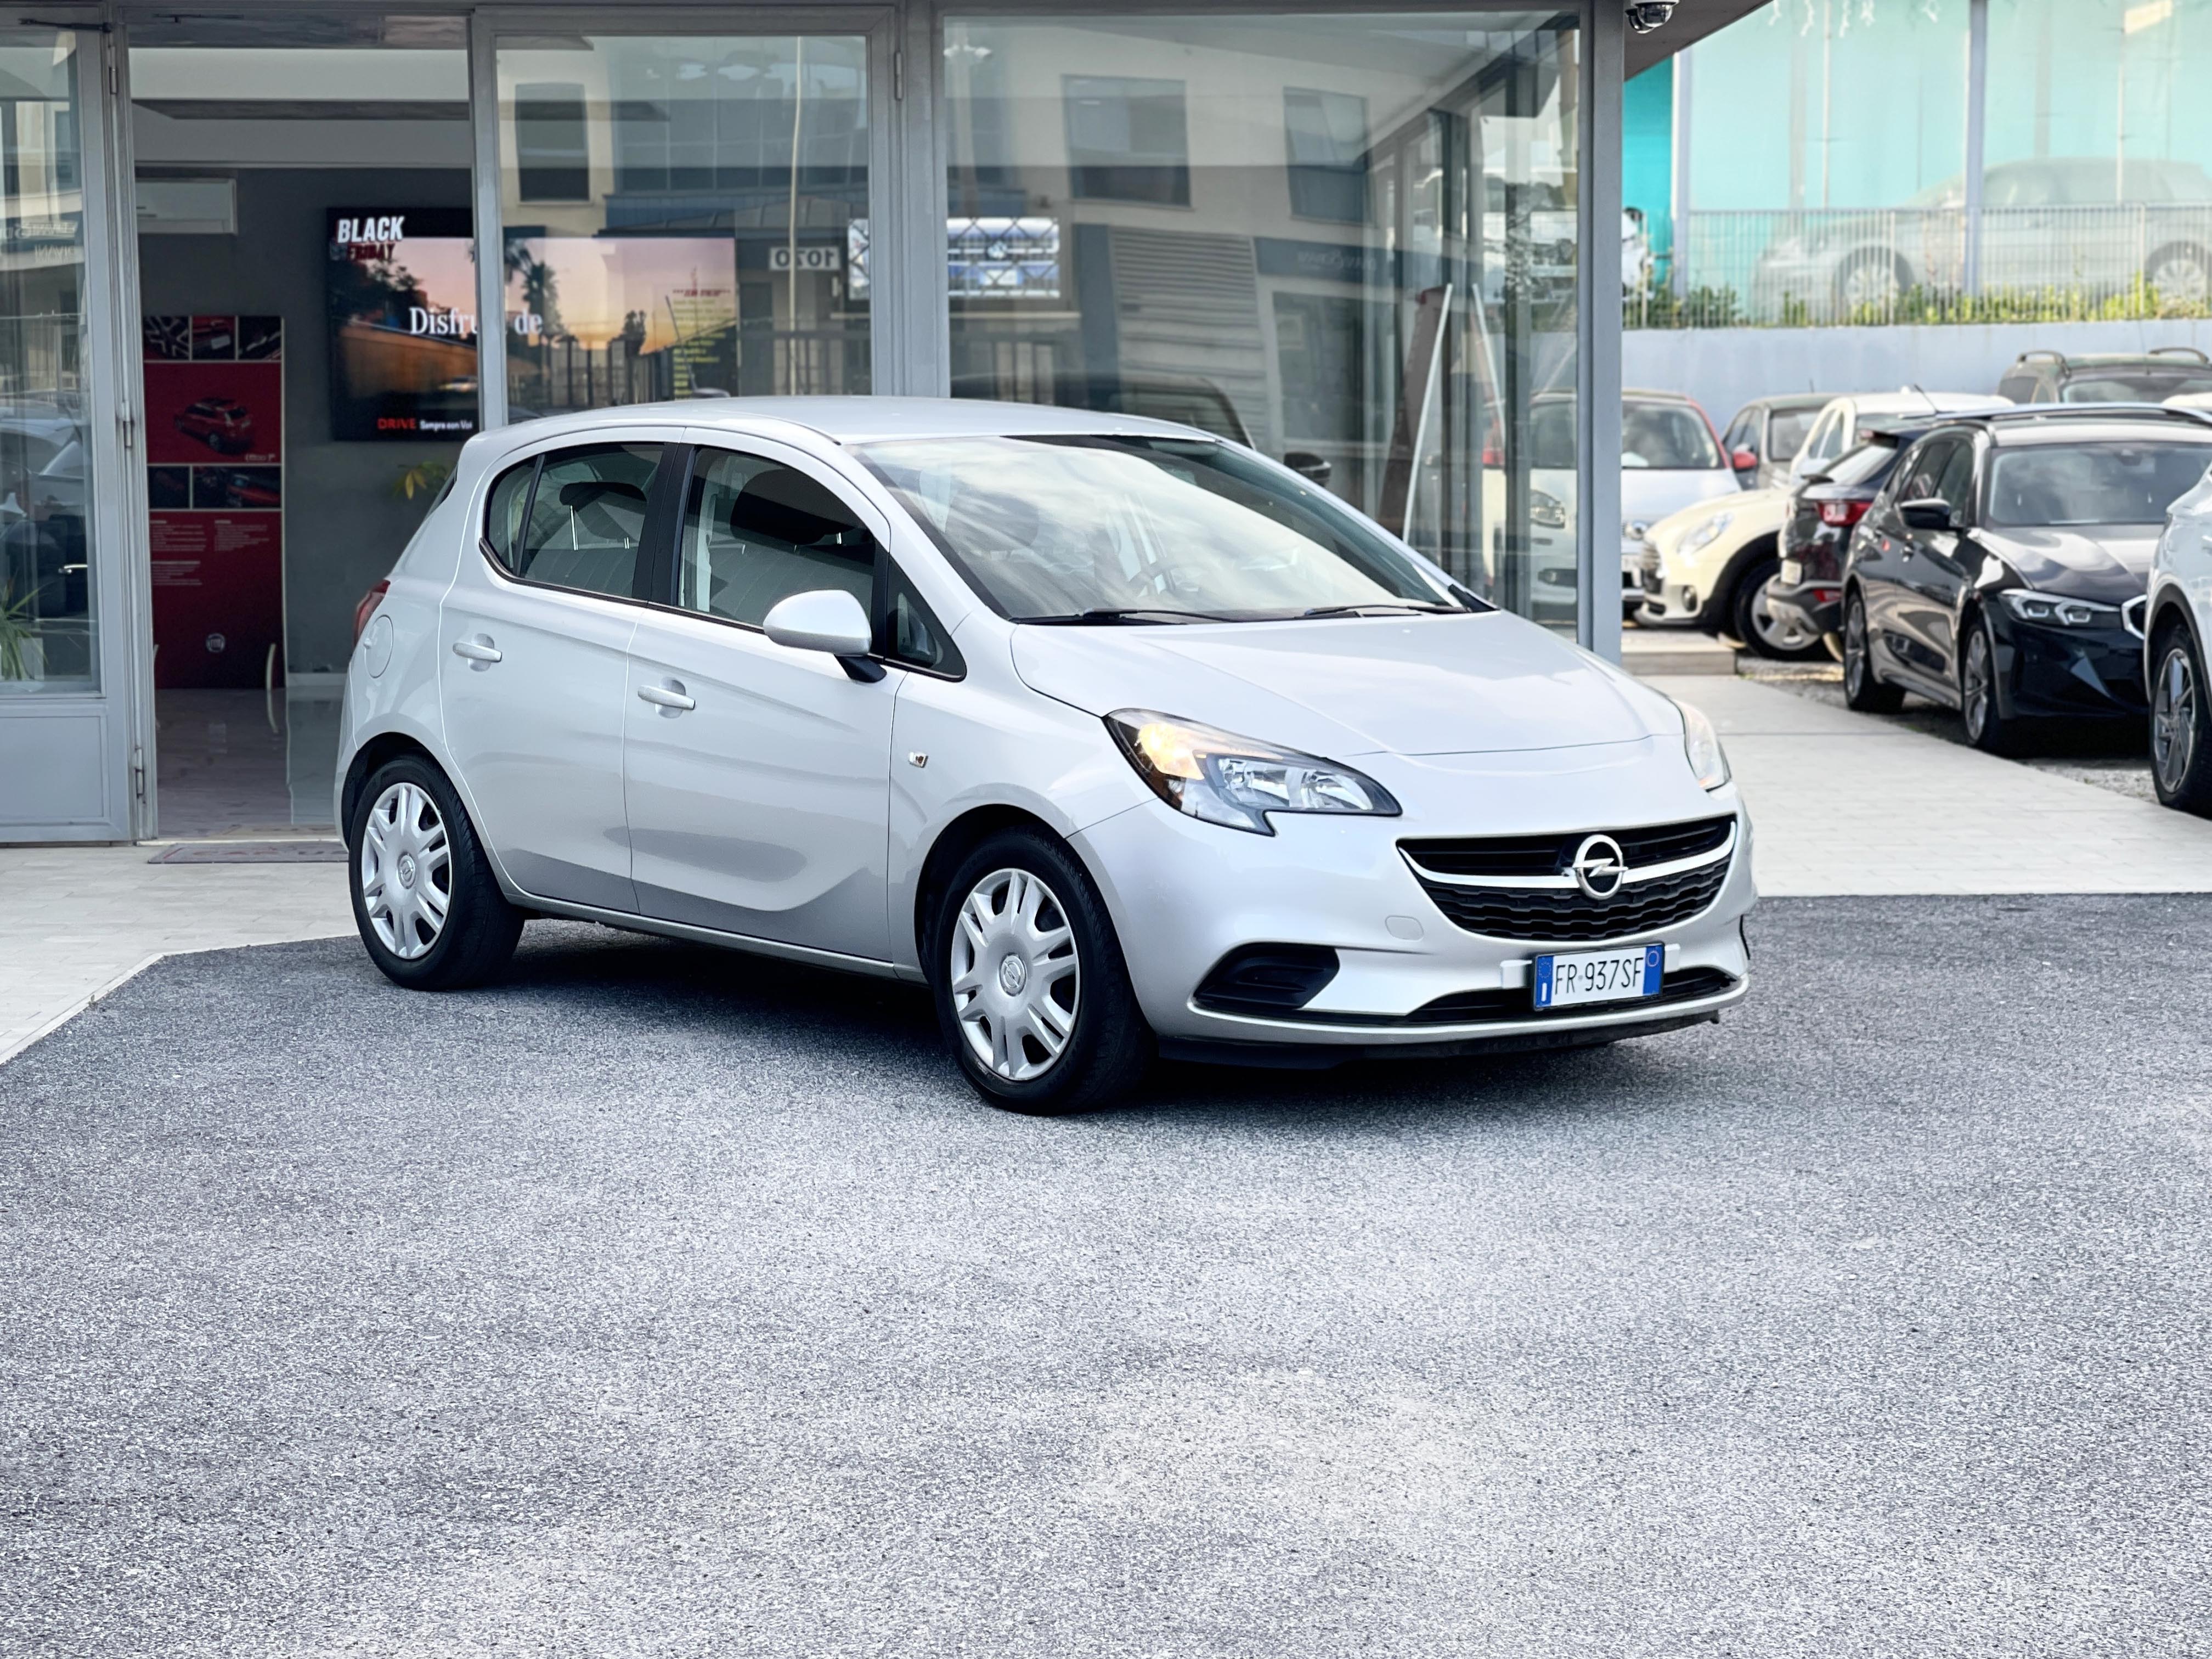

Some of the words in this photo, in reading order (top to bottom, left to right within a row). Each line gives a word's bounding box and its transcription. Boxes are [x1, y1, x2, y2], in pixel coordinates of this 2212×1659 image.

[337, 216, 405, 243] BLACK
[514, 308, 543, 335] de
[377, 418, 416, 430] DRIVE
